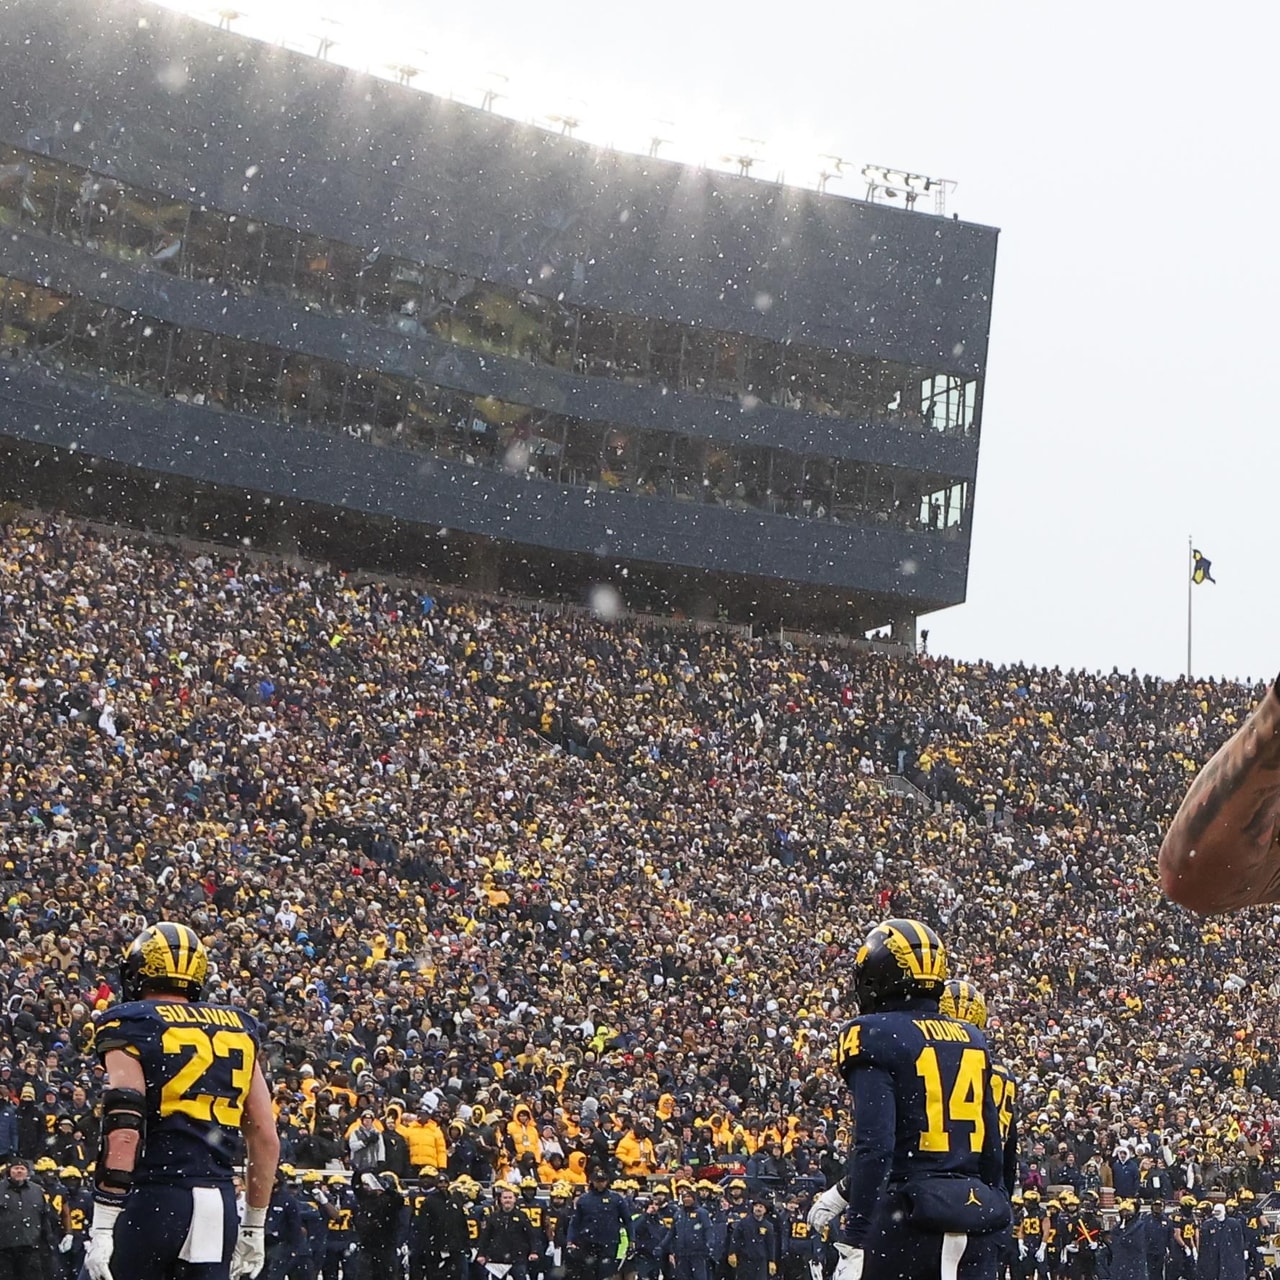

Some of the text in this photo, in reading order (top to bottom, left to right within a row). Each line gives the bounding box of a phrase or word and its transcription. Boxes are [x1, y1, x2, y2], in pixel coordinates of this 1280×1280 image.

[155, 1004, 244, 1029] SULLIVAN
[912, 1019, 971, 1043] YOUNG
[838, 1024, 862, 1066] 14
[161, 1027, 256, 1128] 23
[916, 1046, 987, 1153] 14
